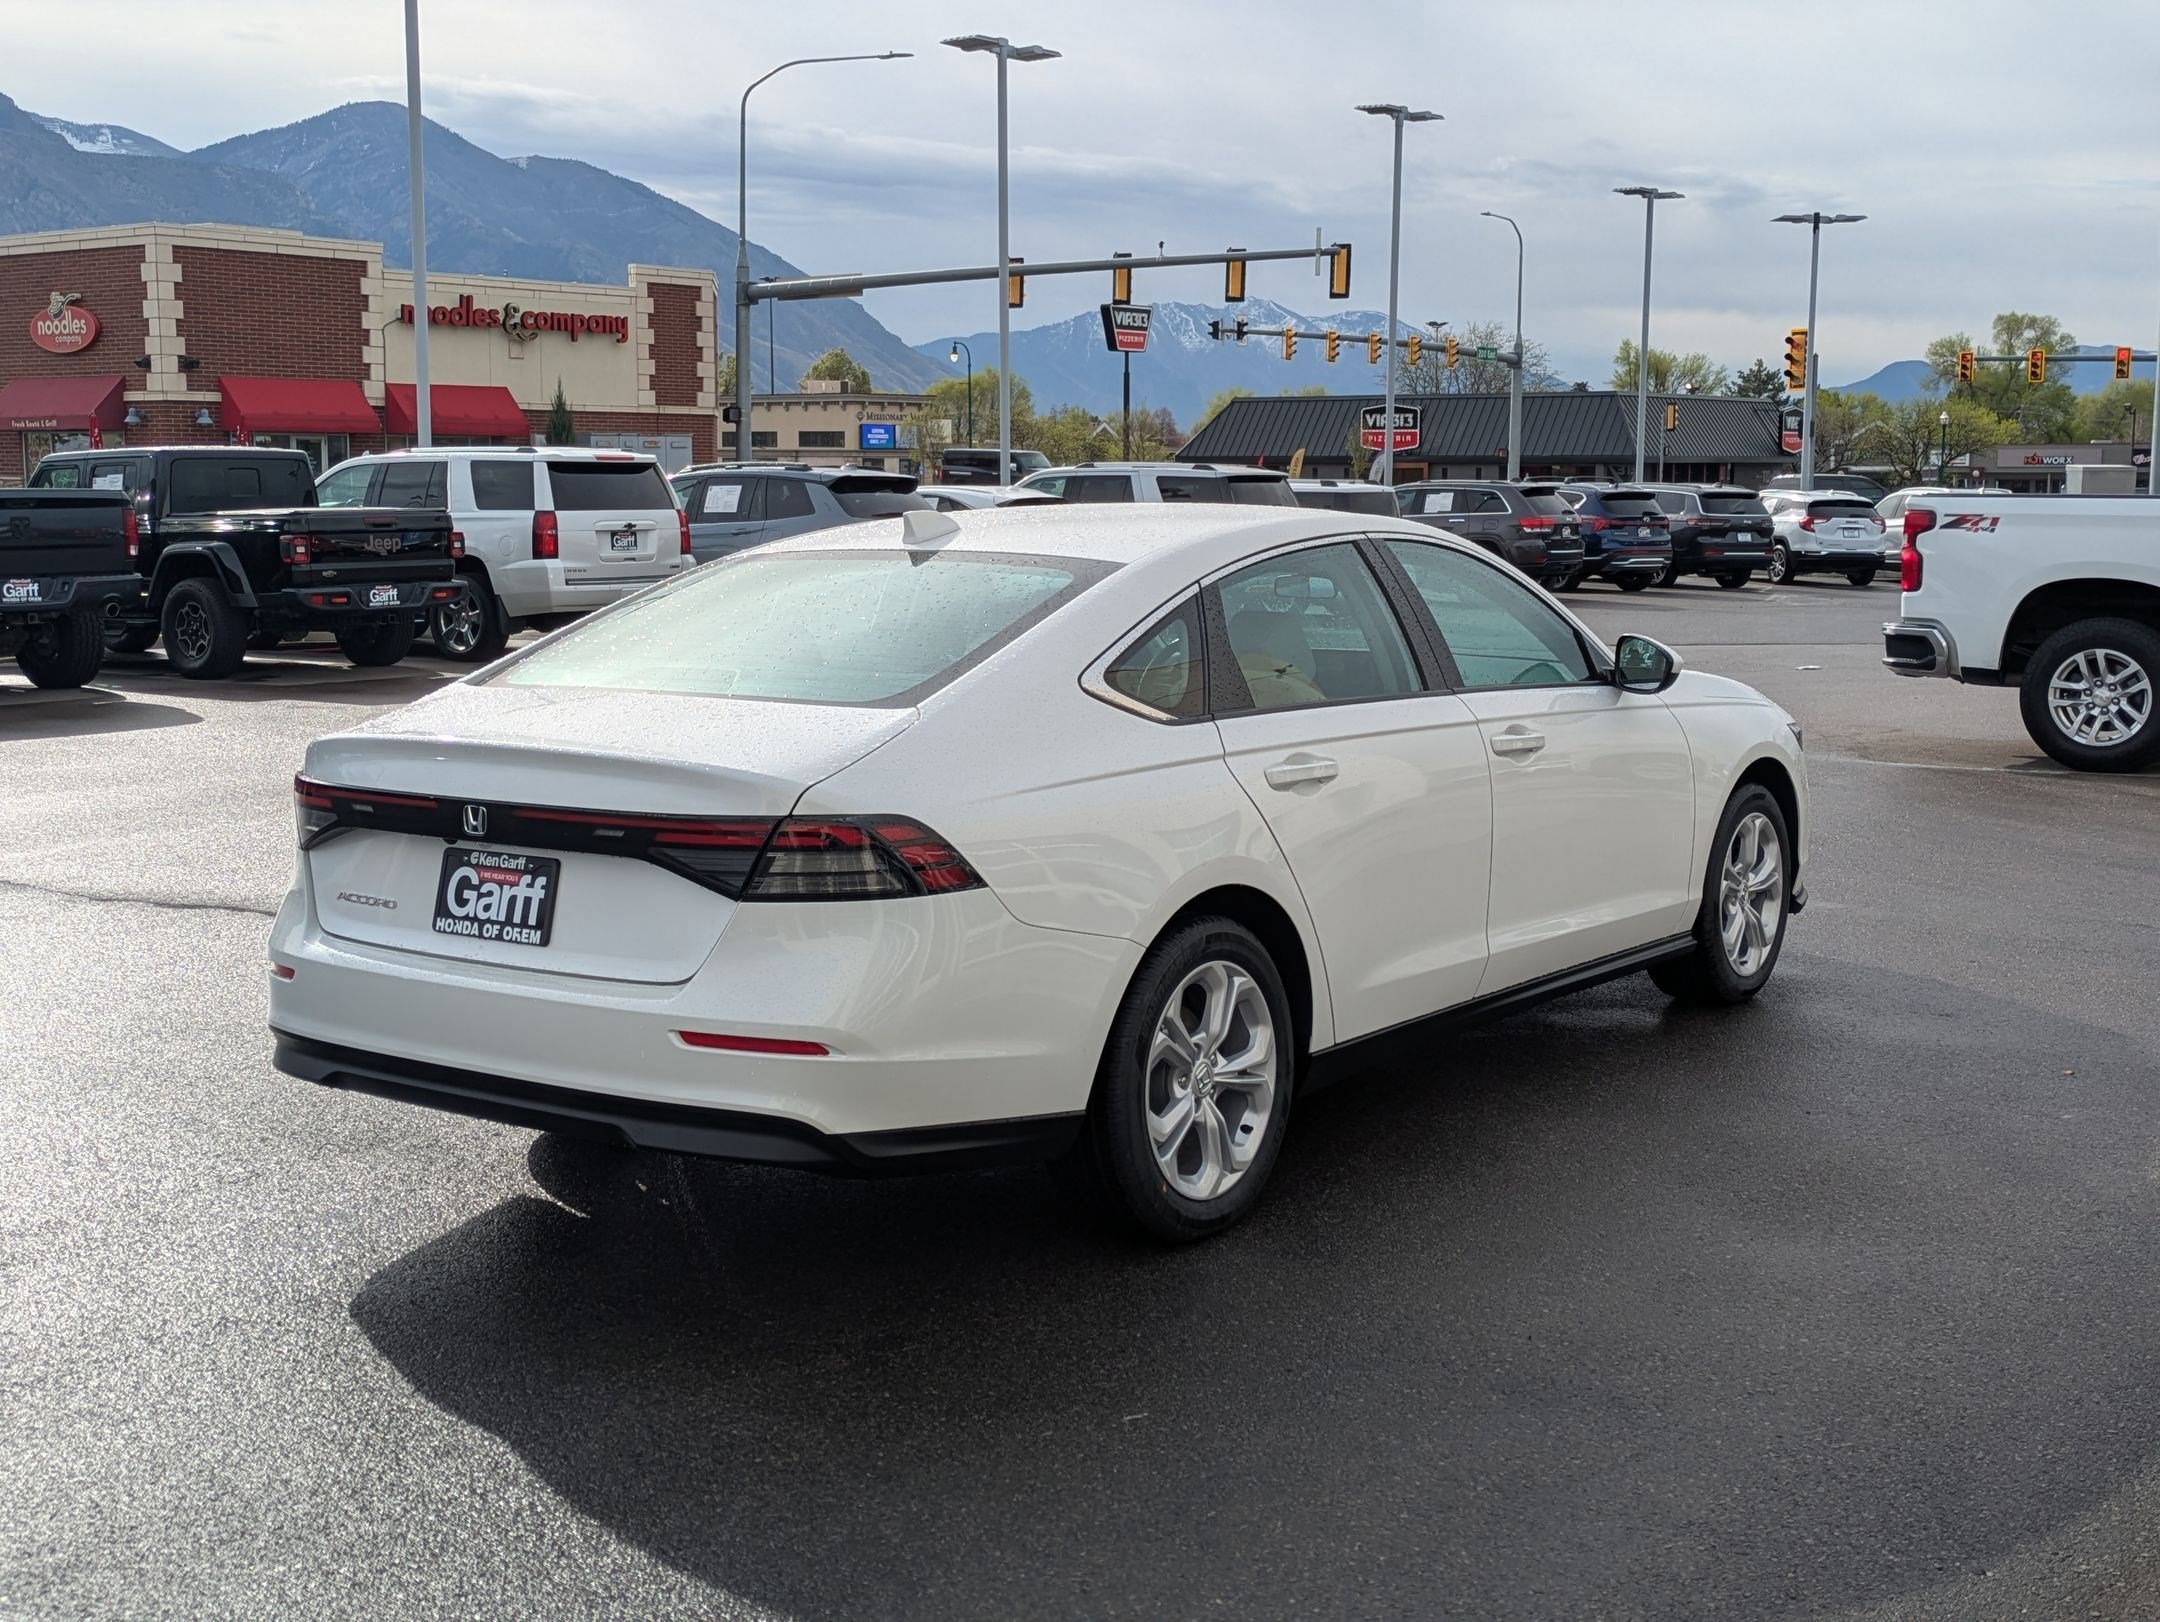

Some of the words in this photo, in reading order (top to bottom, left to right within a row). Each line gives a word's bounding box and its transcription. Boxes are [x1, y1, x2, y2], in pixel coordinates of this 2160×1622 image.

[37, 310, 87, 335] noodles
[400, 294, 500, 328] nodles
[520, 311, 629, 343] company
[55, 335, 82, 345] company
[2024, 455, 2073, 465] HOTWORX
[1939, 514, 2001, 530] Z71
[363, 534, 402, 553] Jeep
[613, 535, 635, 547] Garff
[3, 583, 39, 597] Garff
[369, 589, 398, 602] Garff
[480, 852, 499, 867] Ken
[500, 854, 527, 870] Garff
[337, 892, 398, 910] ACCORD
[447, 866, 547, 926] Garff
[435, 917, 479, 936] HONDA
[482, 923, 500, 938] OF
[503, 926, 542, 945] OREM
